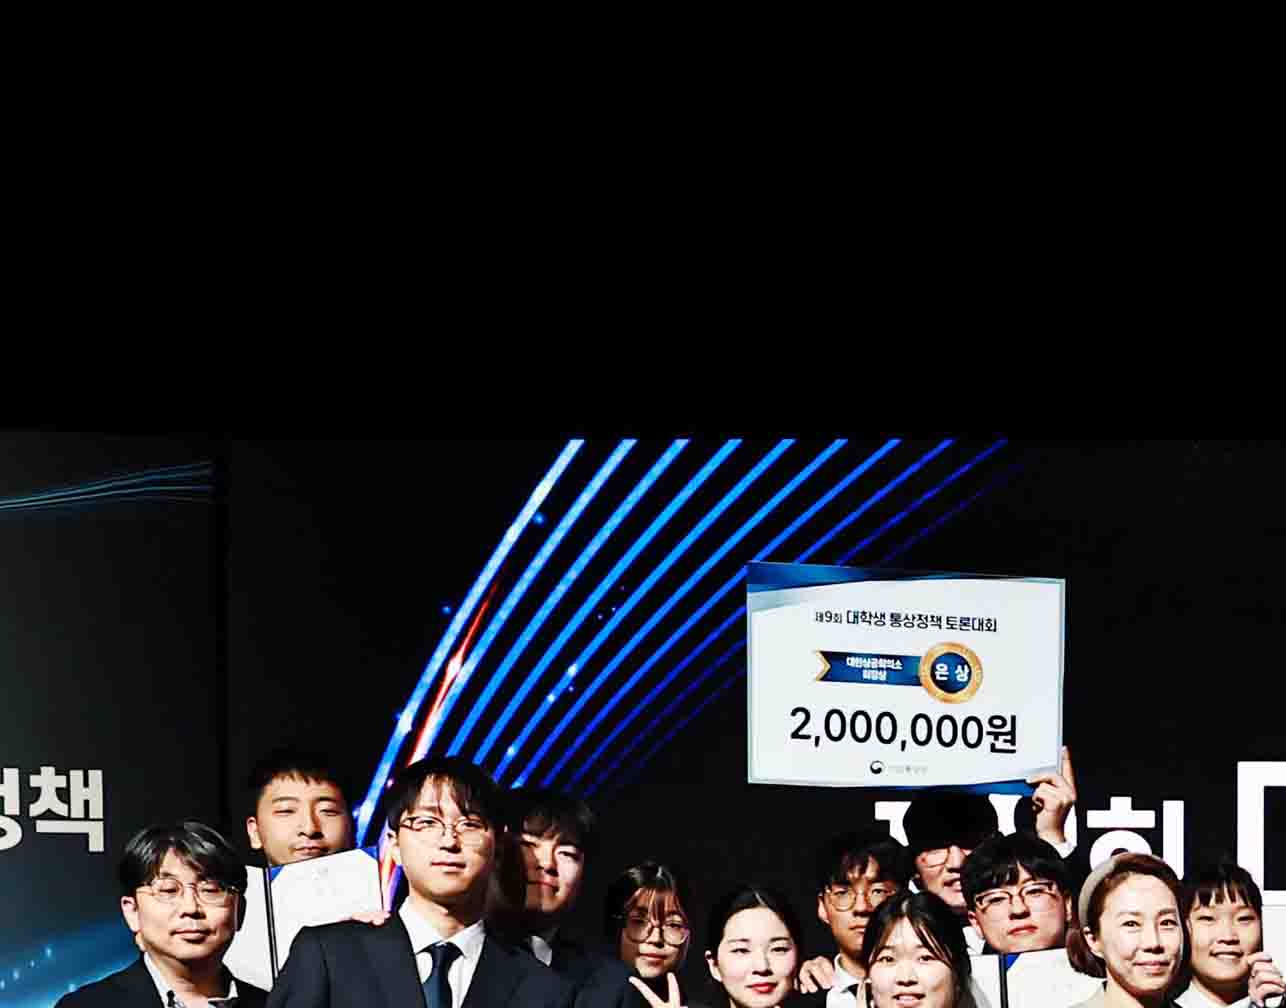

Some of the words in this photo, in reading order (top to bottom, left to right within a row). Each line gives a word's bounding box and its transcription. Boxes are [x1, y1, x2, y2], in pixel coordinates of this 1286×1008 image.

[815, 610, 842, 624] 제9회
[847, 610, 886, 627] 대학생
[890, 612, 942, 629] 통상정책
[945, 617, 997, 632] 토론대회
[789, 706, 1017, 754] 2,000,000원
